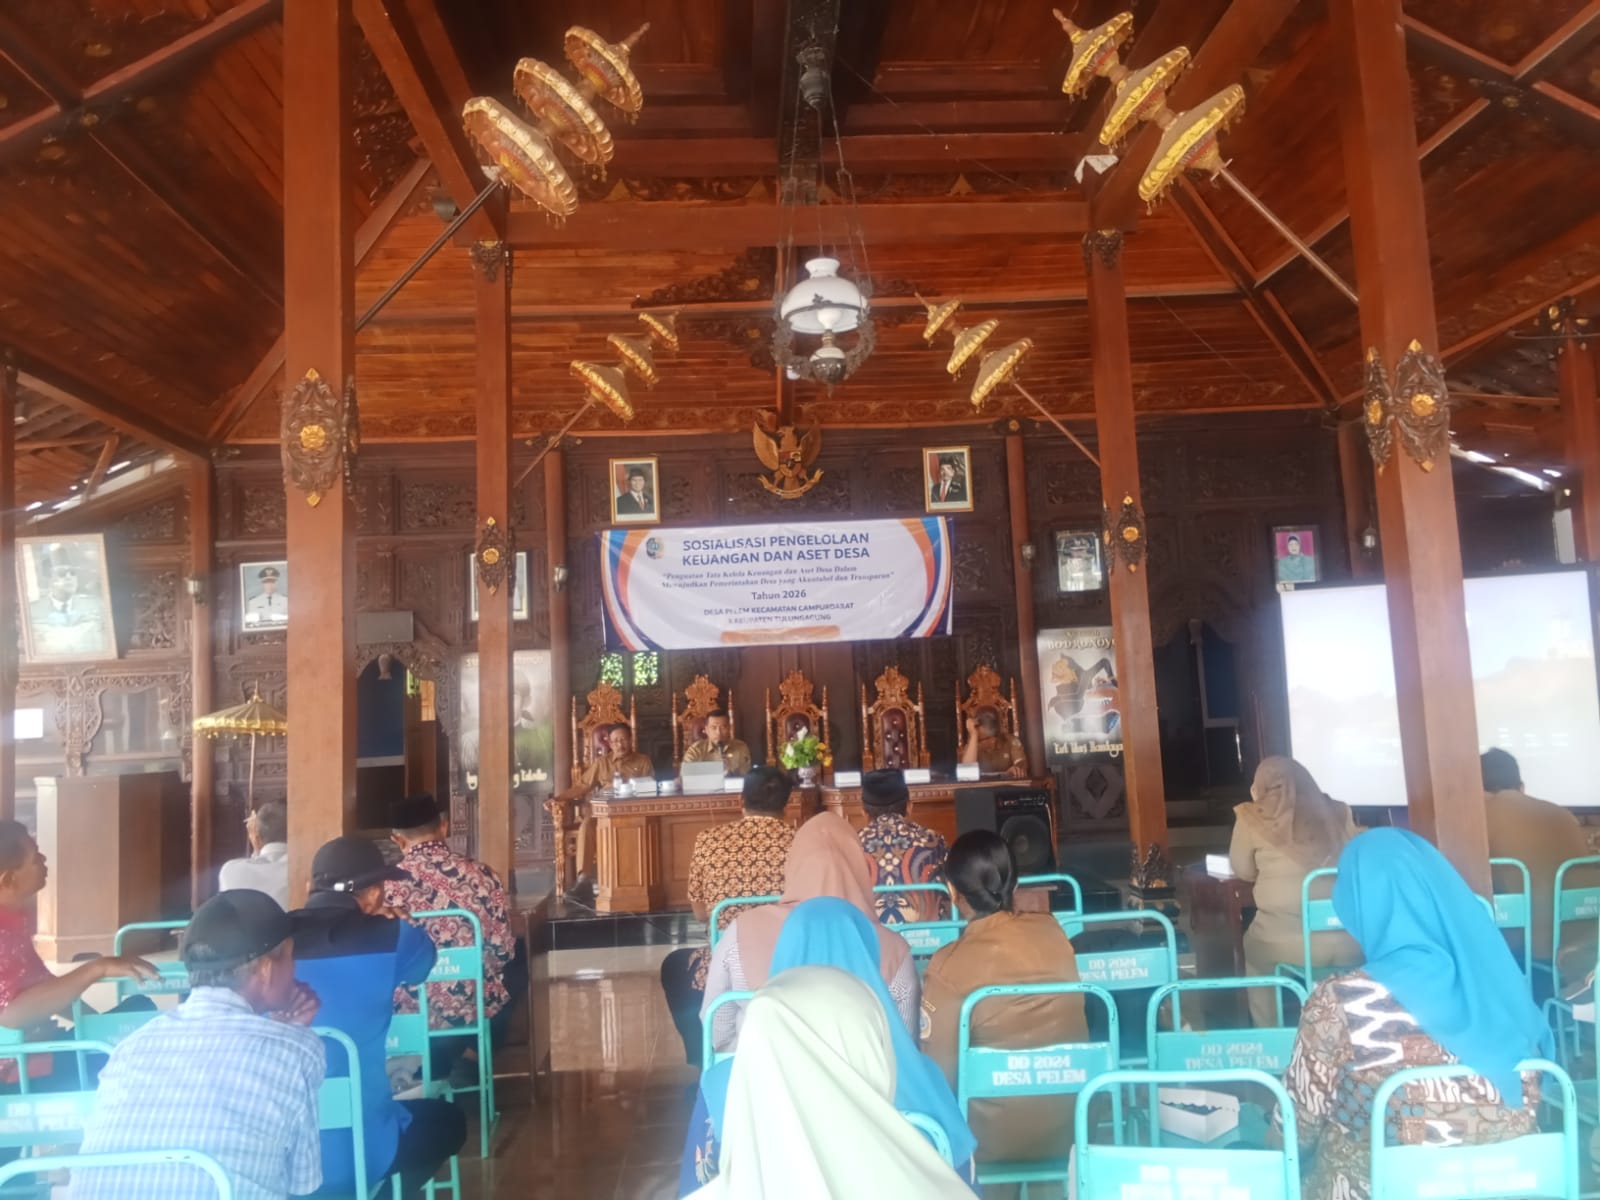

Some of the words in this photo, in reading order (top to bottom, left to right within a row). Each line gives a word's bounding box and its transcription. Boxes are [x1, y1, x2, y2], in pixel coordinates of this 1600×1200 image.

[683, 537, 766, 551] SOSIALISASI
[770, 533, 869, 547] PENGELOLAAN
[682, 552, 760, 566] KEUANGAN
[763, 550, 793, 562] DAN
[796, 549, 831, 560] ASET
[834, 547, 870, 559] DESA
[751, 591, 780, 600] Tahun
[783, 589, 807, 599] 2026
[751, 606, 797, 614] KECAMATAN
[1111, 967, 1149, 980] PELEM
[1007, 1055, 1031, 1070] DD
[1033, 1055, 1071, 1068] 2024
[1230, 1055, 1279, 1069] PELEM
[992, 1071, 1032, 1086] DESA
[1036, 1069, 1087, 1084] PELEM
